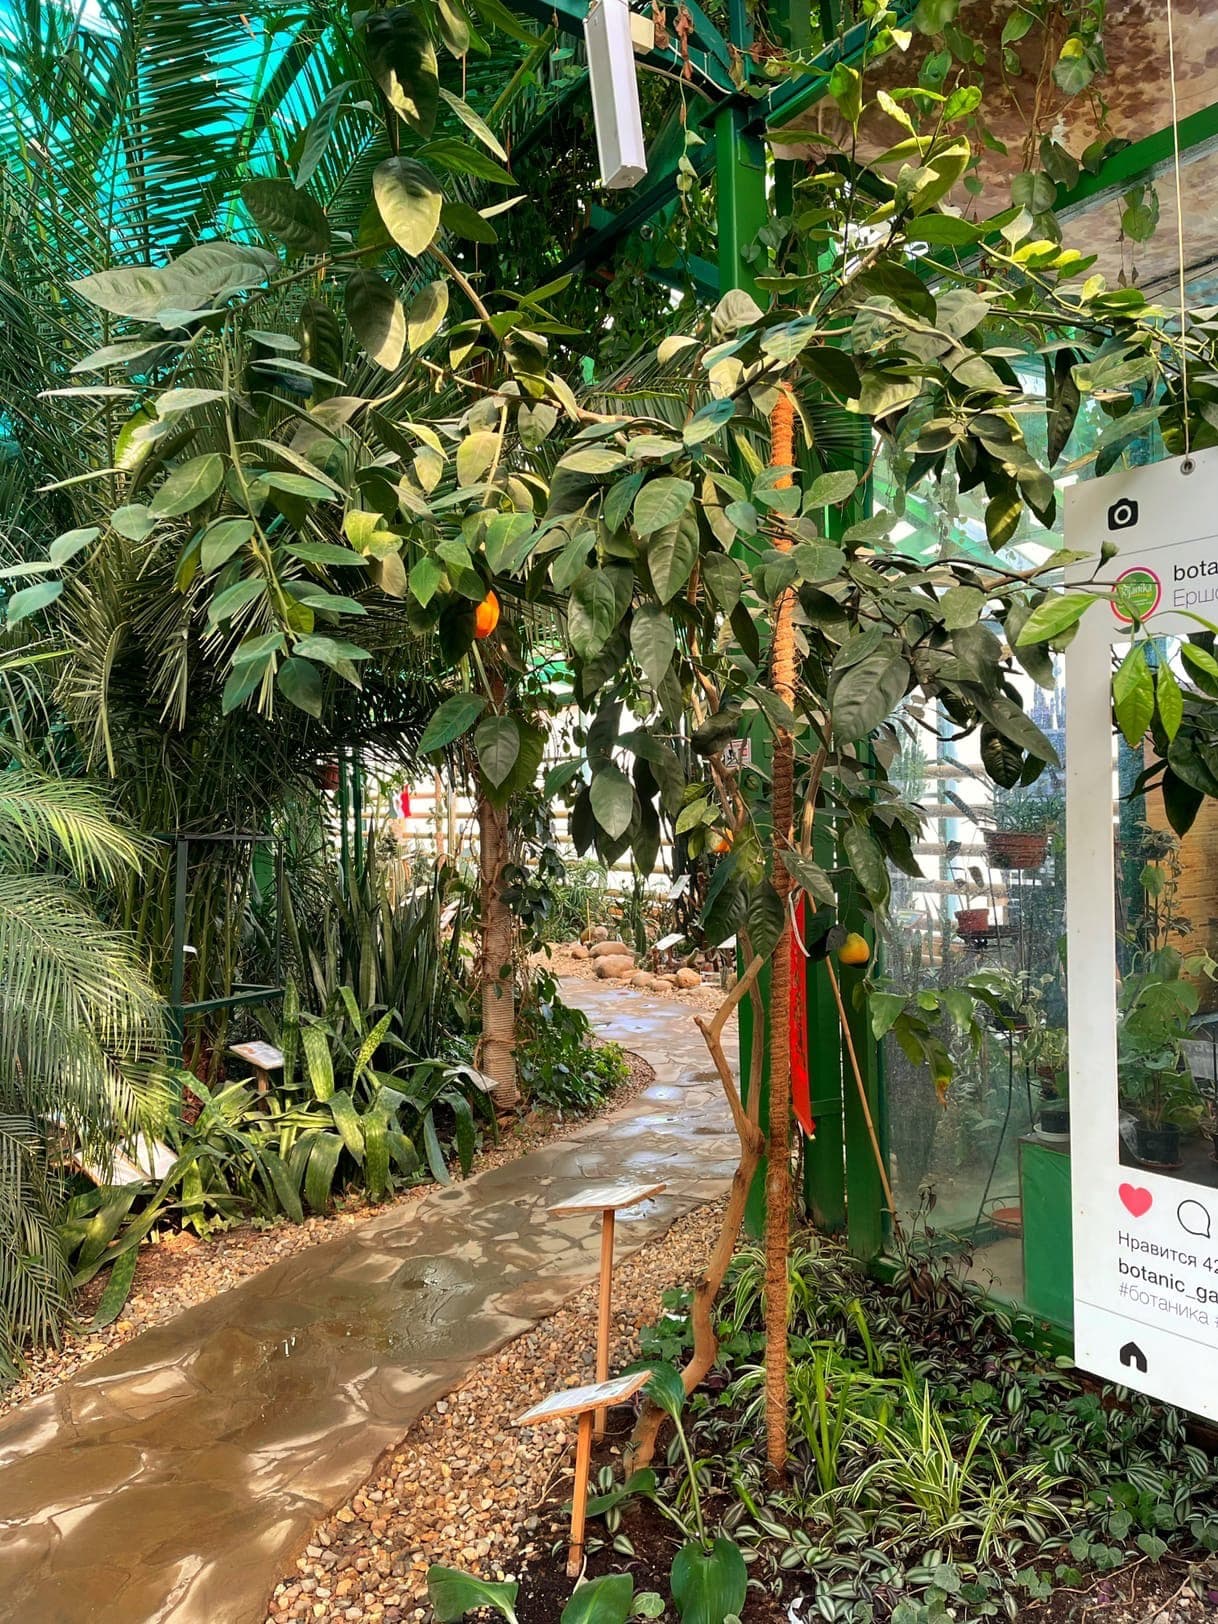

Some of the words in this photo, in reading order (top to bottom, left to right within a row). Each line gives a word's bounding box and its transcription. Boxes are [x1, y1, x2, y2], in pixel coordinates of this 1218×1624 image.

[1174, 560, 1218, 582] bota
[1118, 1230, 1197, 1268] Нравится
[1118, 1257, 1218, 1304] botanic_ga
[1119, 1281, 1210, 1326] #ботаника
